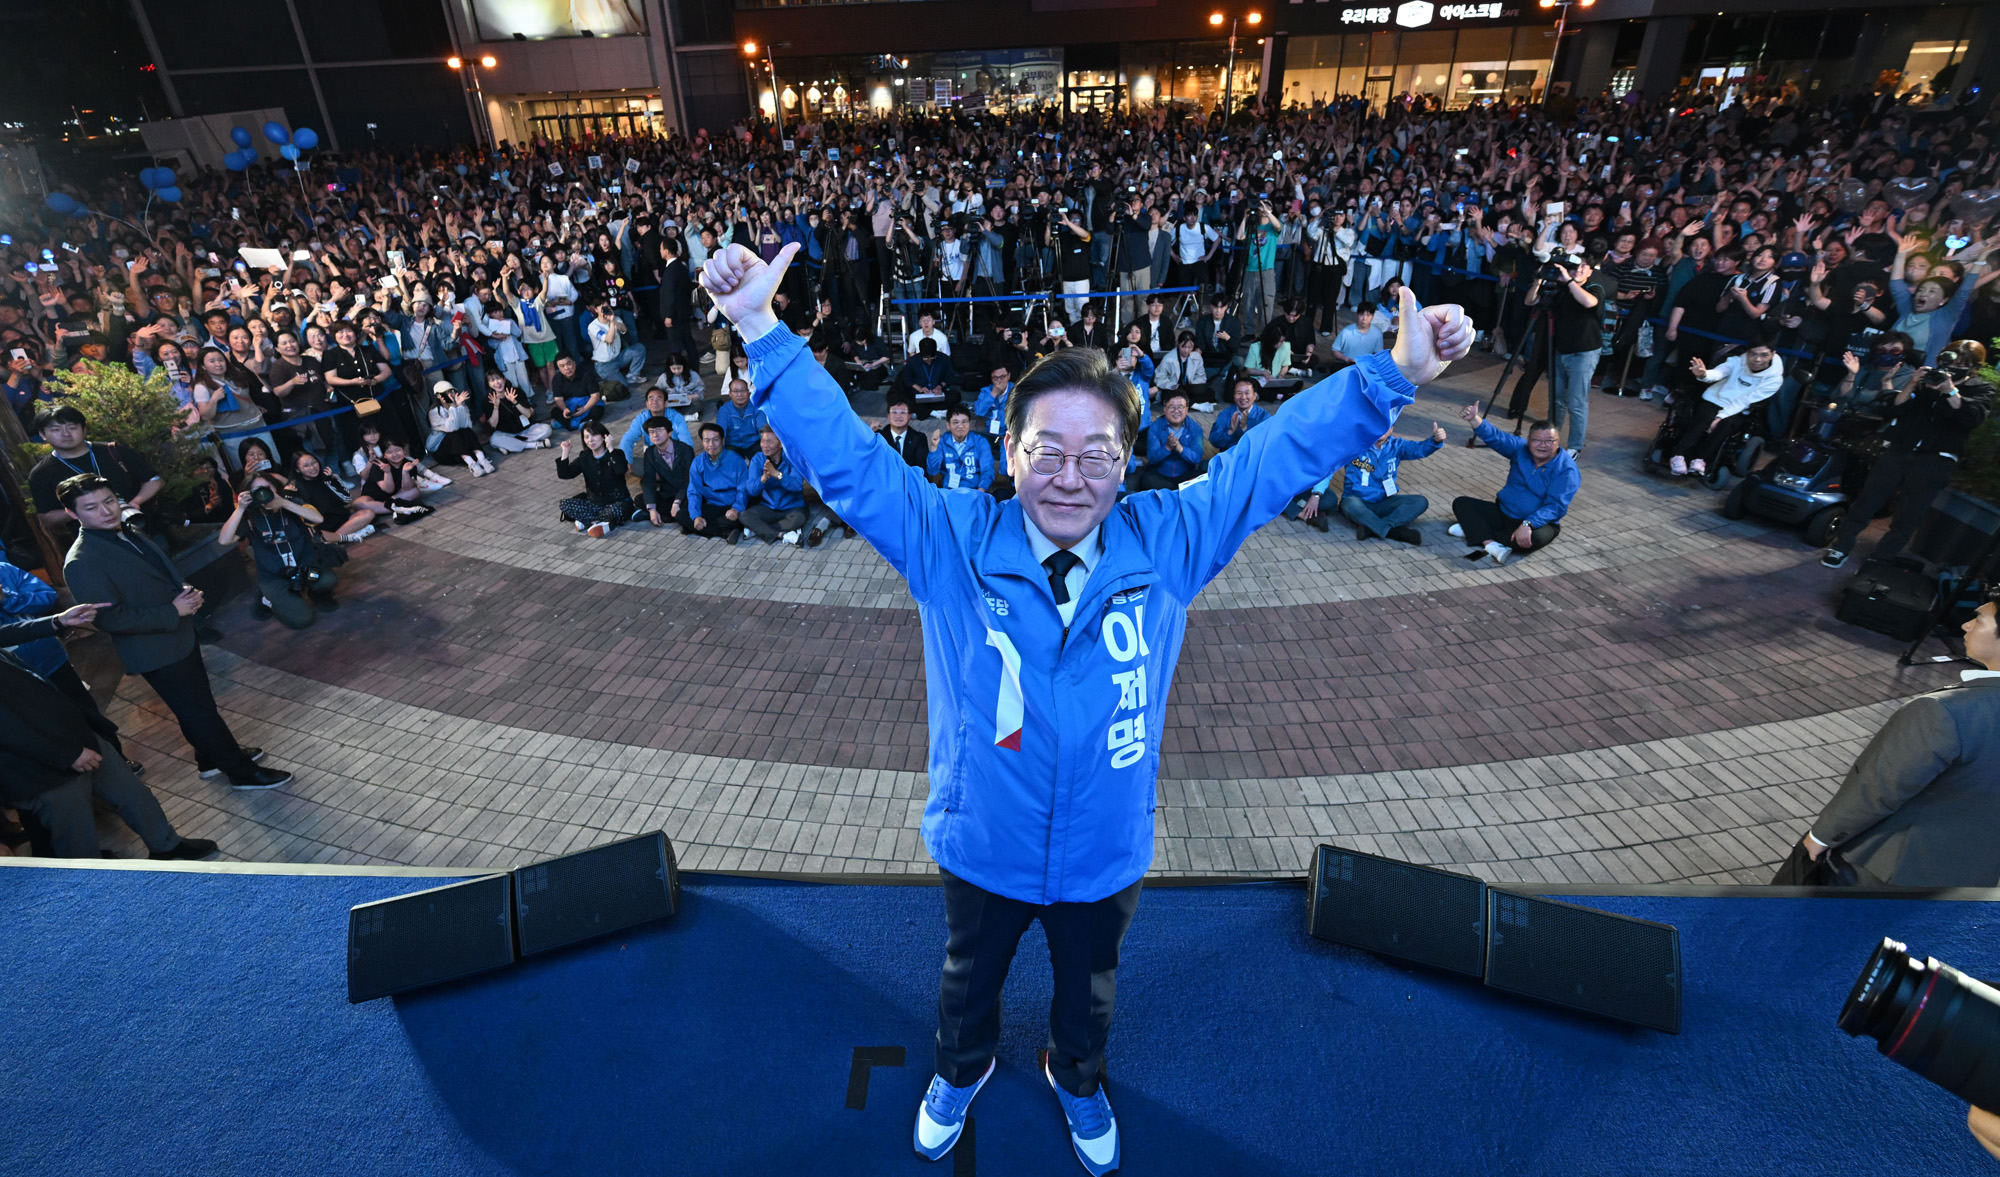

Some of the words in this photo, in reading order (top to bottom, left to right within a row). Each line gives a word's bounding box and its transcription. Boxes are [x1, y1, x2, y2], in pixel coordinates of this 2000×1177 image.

[1440, 3, 1502, 20] 아이스크림
[982, 594, 1010, 616] 주당
[985, 626, 1025, 753] 1
[1102, 605, 1150, 769] 이재명
